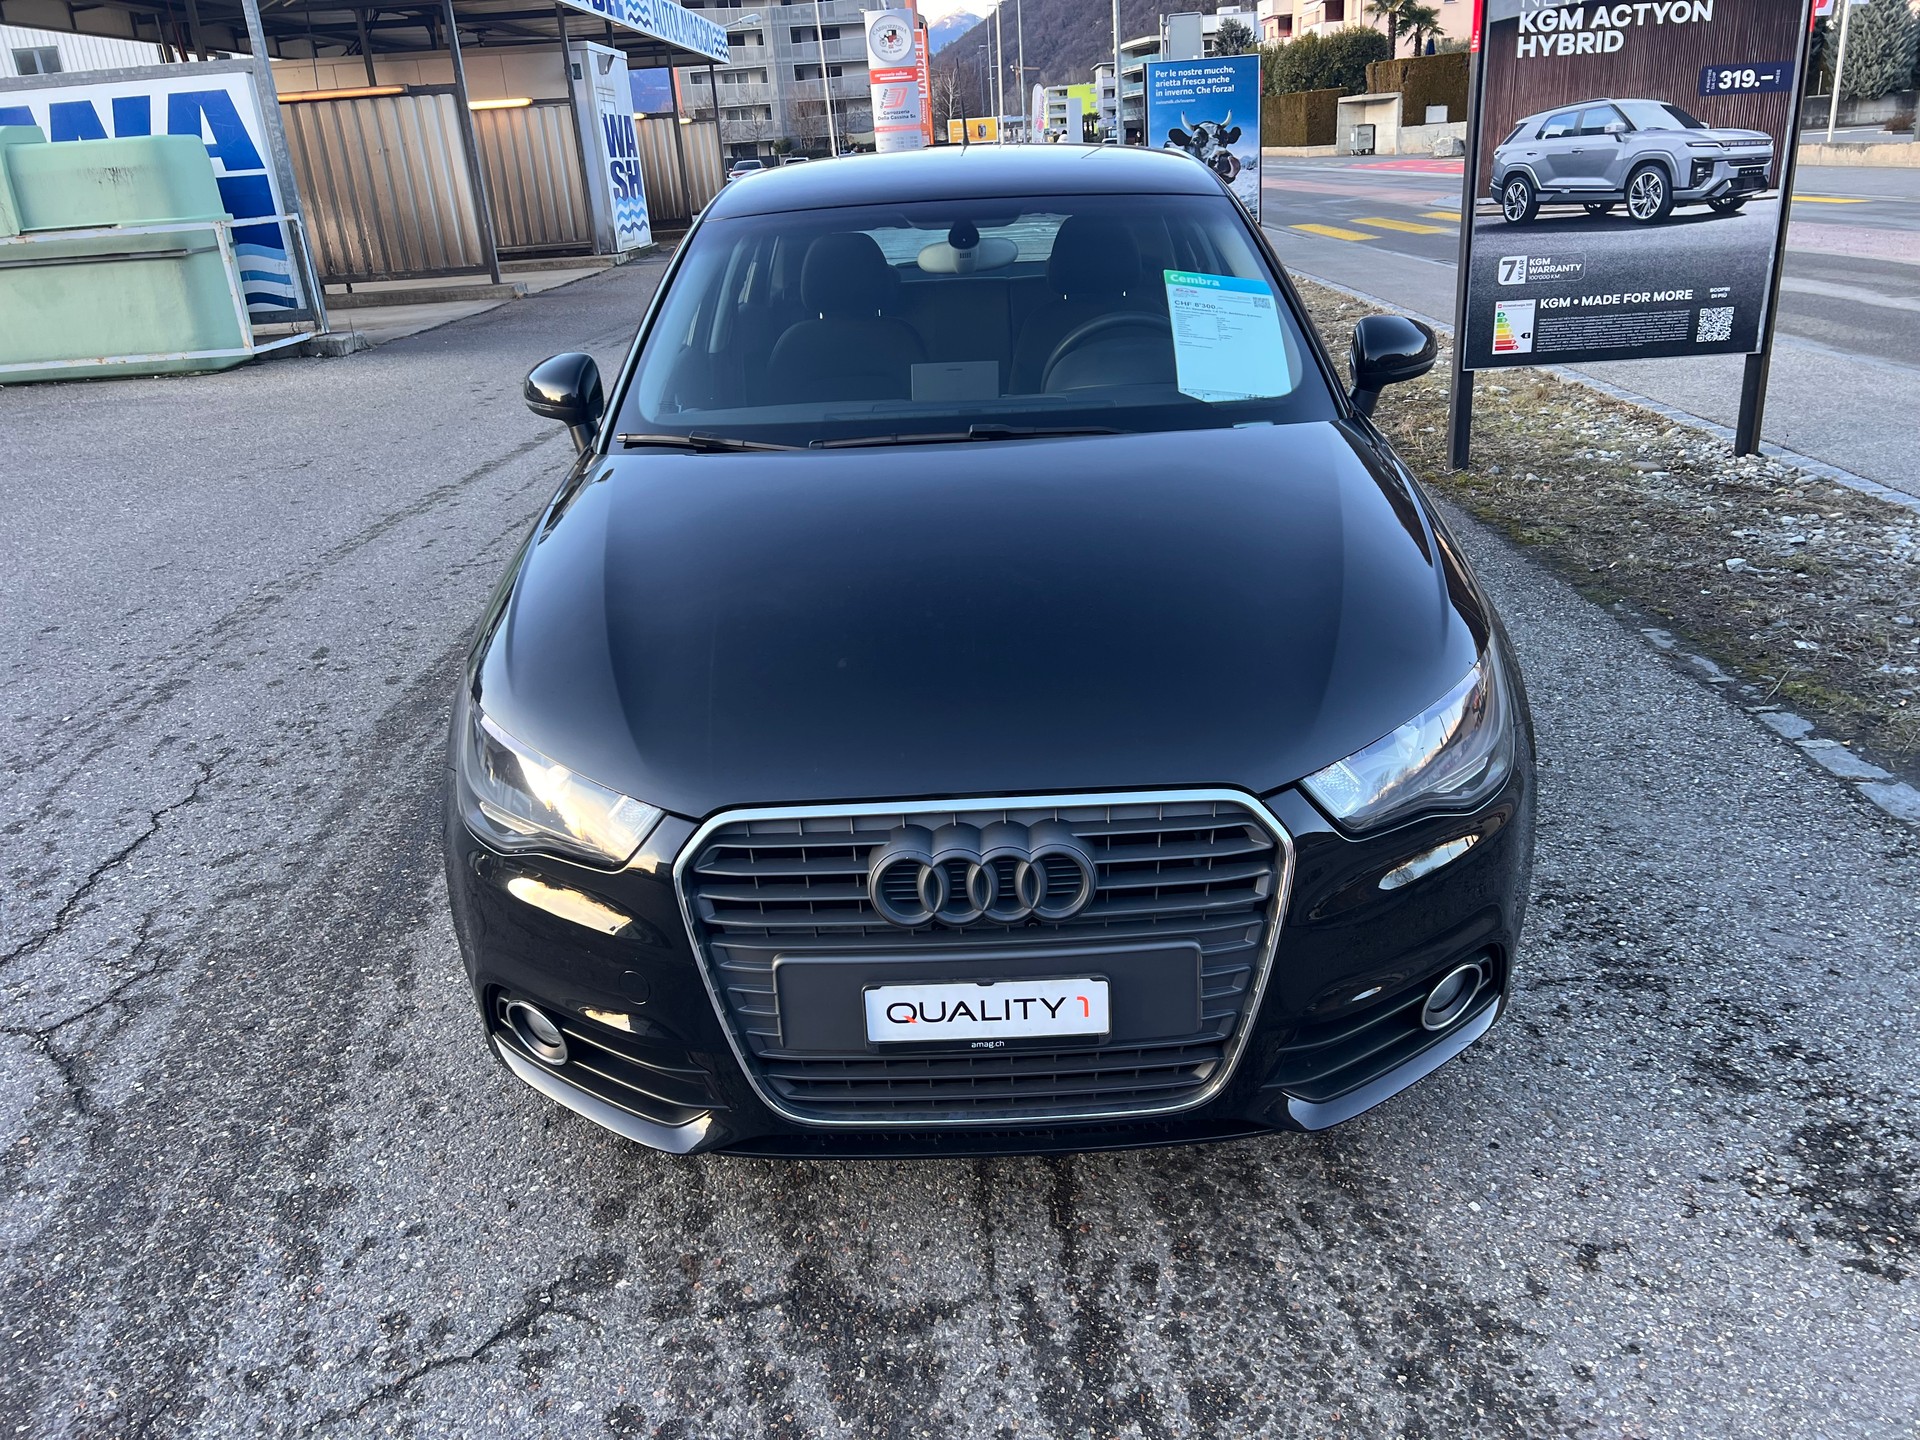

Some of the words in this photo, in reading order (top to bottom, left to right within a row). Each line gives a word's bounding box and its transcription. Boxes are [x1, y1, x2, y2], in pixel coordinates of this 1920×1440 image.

[1518, 7, 1584, 33] KGM
[1589, 0, 1713, 28] ACTYON
[652, 3, 714, 55] AUTOLAVAGGIO
[1516, 30, 1624, 58] HYBRID
[1155, 70, 1168, 78] Per
[1170, 69, 1176, 77] le
[1178, 68, 1202, 76] nostre
[1204, 65, 1235, 75] mucche,
[1155, 79, 1181, 87] arietta
[1182, 77, 1205, 86] fresca
[1207, 75, 1230, 84] anche
[1155, 89, 1163, 97] in
[1164, 87, 1195, 96] inverno.
[1196, 86, 1210, 94] Che
[1212, 84, 1235, 93] forza!
[603, 113, 638, 158] WA
[610, 160, 645, 201] SH
[1502, 260, 1517, 281] 7
[1517, 259, 1525, 281] YEAR
[1529, 257, 1551, 266] KGM
[1529, 263, 1582, 274] WARRANTY
[1170, 273, 1220, 287] Cembra
[1540, 298, 1571, 309] KGM
[1581, 295, 1621, 307] MADE
[1623, 292, 1650, 304] FOR
[1653, 289, 1693, 302] MORE
[886, 996, 1067, 1024] QUALITY
[971, 1040, 1005, 1049] amag.ch
